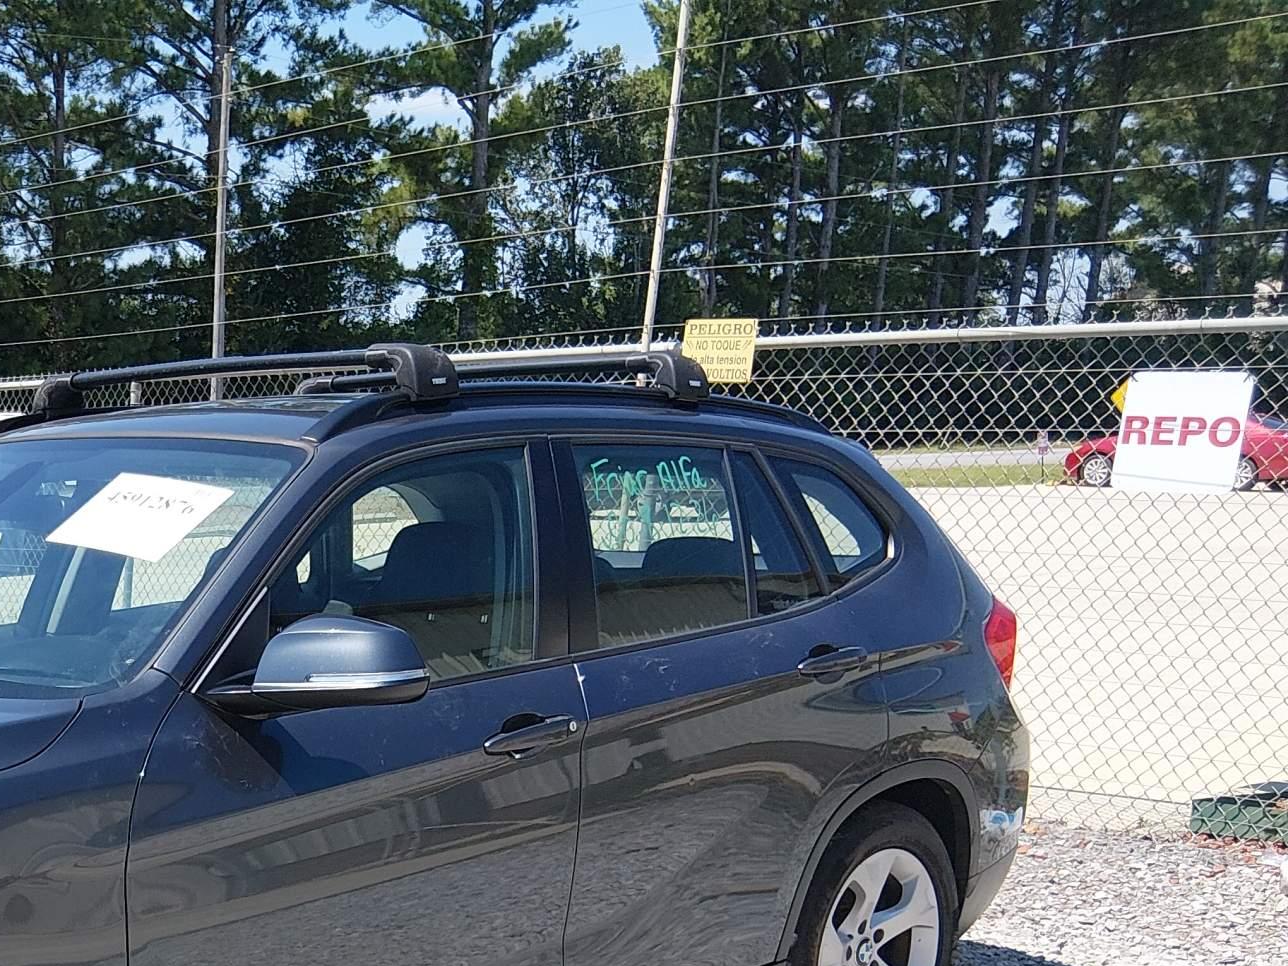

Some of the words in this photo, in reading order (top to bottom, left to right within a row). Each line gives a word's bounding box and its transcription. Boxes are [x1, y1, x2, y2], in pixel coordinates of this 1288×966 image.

[688, 323, 753, 335] PELIGRO
[695, 340, 709, 350] NO
[711, 340, 741, 351] TOQUE
[700, 355, 714, 365] alta
[716, 355, 747, 365] tension
[706, 368, 747, 380] VOLTIOS
[1121, 416, 1241, 448] REPO
